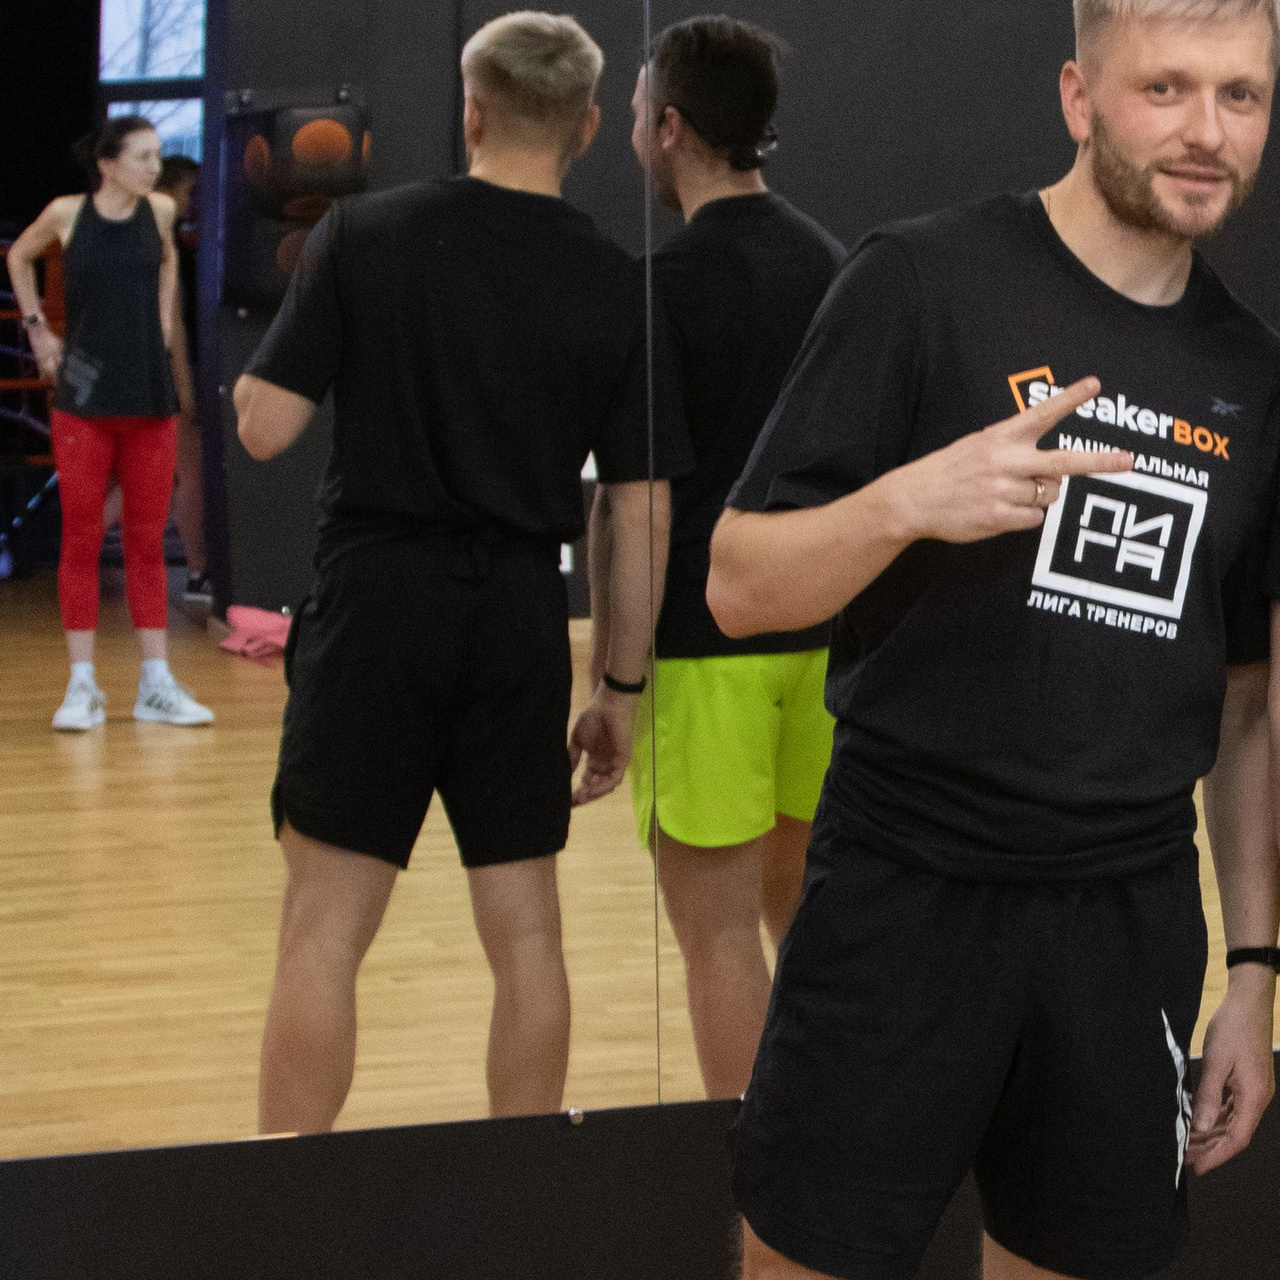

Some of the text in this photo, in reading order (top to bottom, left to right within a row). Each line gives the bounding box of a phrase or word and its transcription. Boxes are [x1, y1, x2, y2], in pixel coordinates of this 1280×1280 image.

[1059, 432, 1210, 489] НАЦИАЛЬНАЯ
[1027, 589, 1178, 640] ЛИГА ТРЕНЕРОВ
